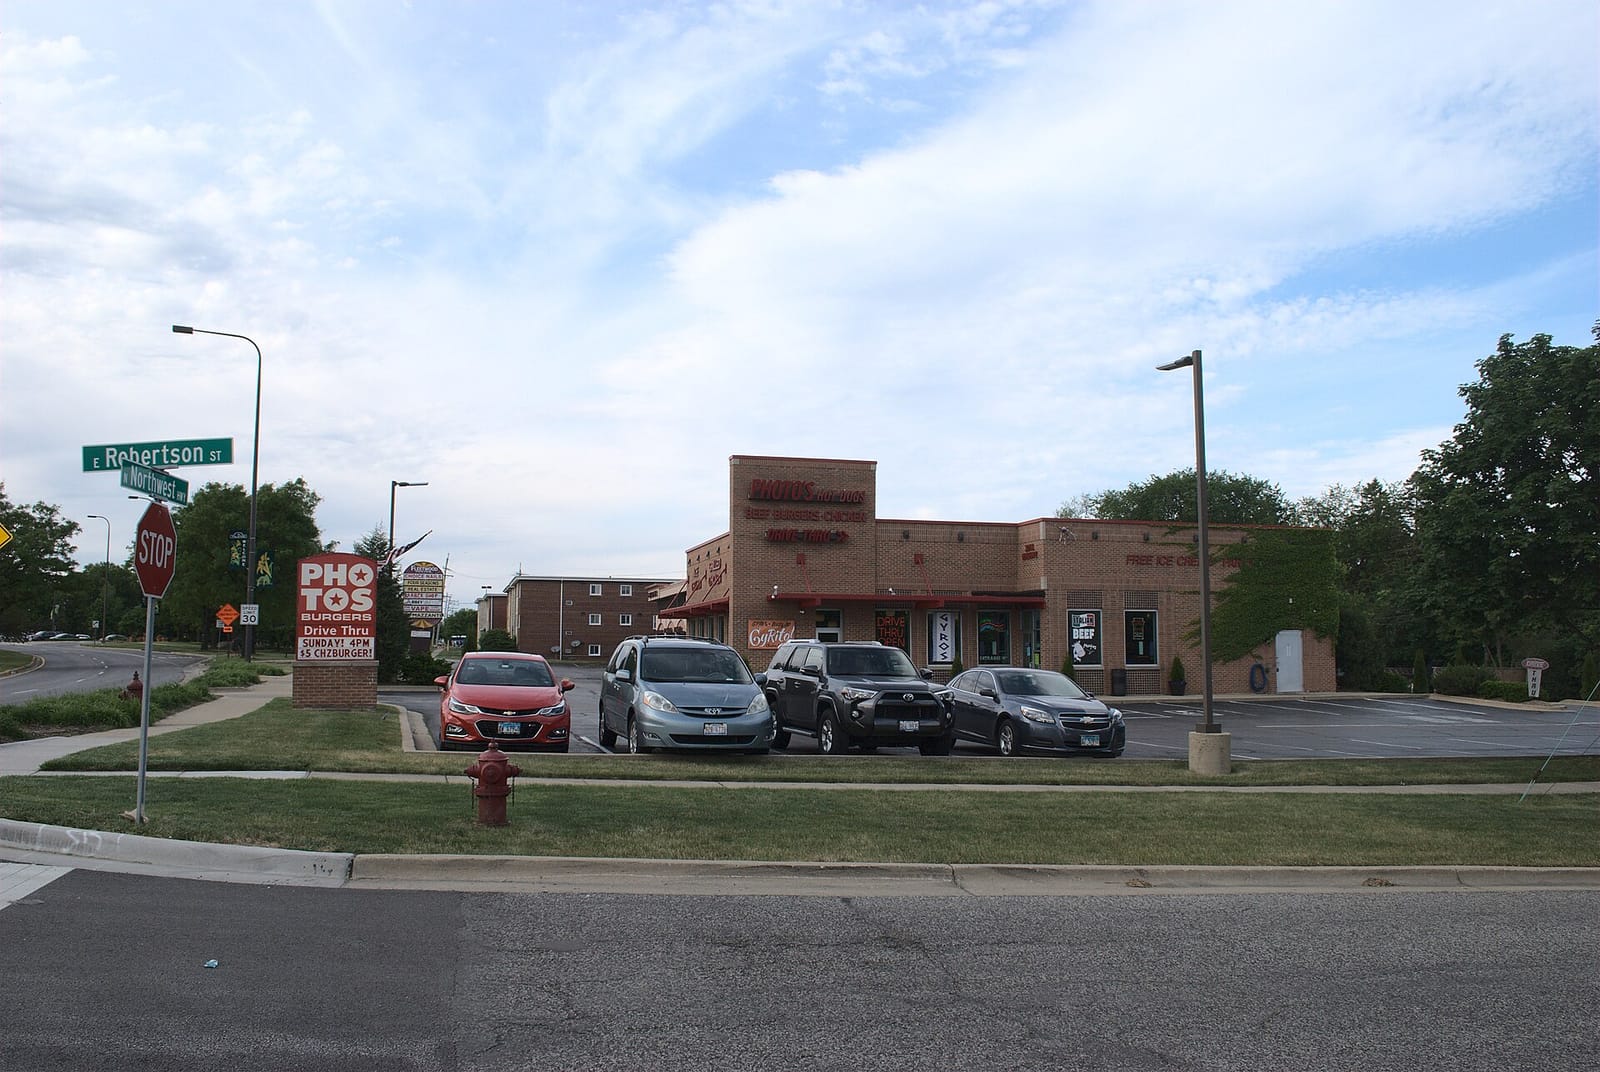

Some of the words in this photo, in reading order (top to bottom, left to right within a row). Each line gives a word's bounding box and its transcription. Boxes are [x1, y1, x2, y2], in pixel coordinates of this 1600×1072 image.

[93, 457, 100, 469] E
[105, 444, 204, 468] Robertson
[209, 450, 222, 462] ST
[130, 465, 177, 500] Northwest
[138, 529, 173, 569] STOP
[1126, 555, 1154, 566] FREE
[1156, 556, 1173, 567] ICE
[242, 614, 257, 623] 30
[301, 613, 372, 621] BURGERS
[876, 616, 905, 627] DRIVE
[1073, 615, 1094, 624] ITALIAN
[304, 625, 337, 636] Drive
[341, 625, 369, 636] Thru
[880, 627, 904, 638] THRU
[1072, 628, 1095, 640] BEEF
[938, 613, 949, 661] GYROS
[302, 638, 345, 648] SUNDAY!
[349, 638, 370, 648] 4PM
[300, 649, 311, 658] $5
[314, 649, 373, 658] CHZBURGER!
